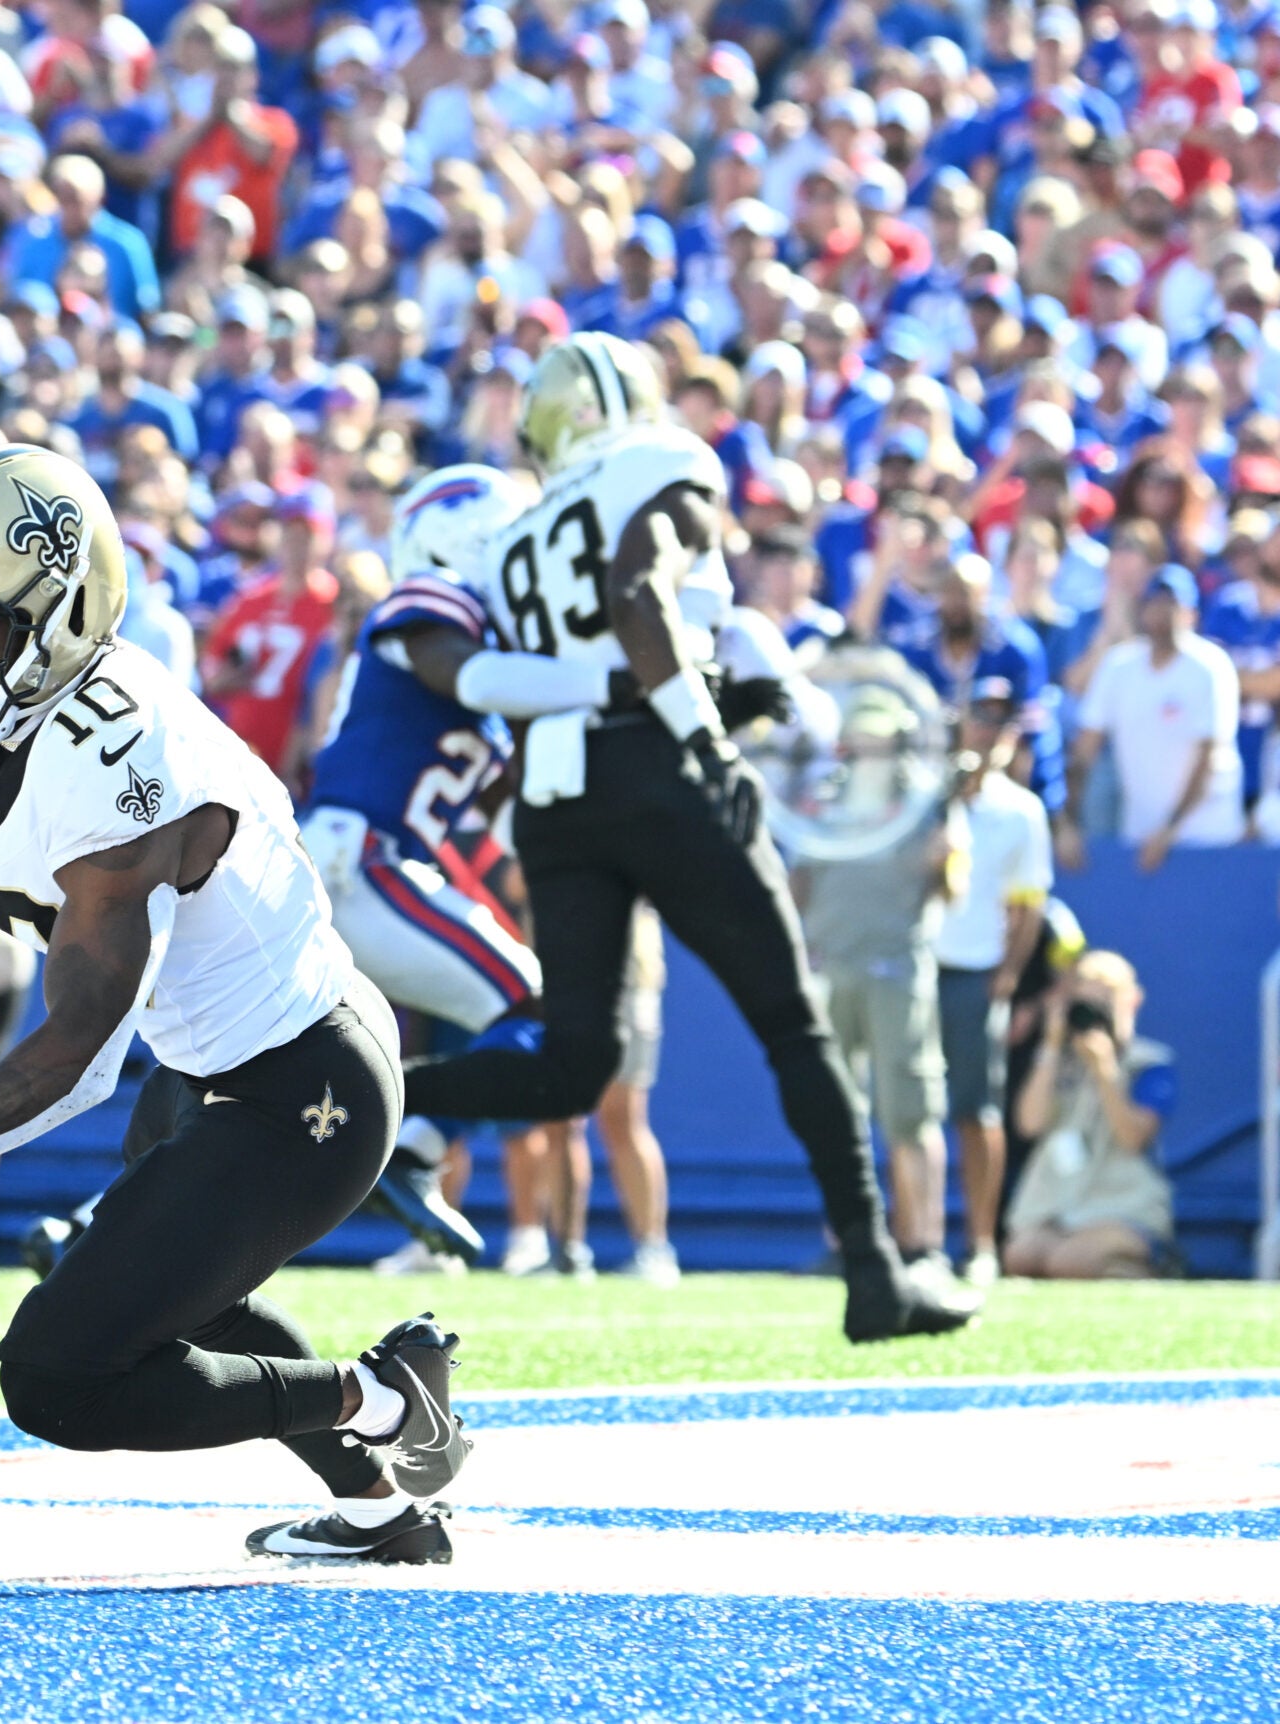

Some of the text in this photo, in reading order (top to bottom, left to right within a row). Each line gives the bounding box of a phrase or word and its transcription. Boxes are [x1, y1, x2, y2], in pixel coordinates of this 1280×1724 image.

[501, 496, 611, 658] 83
[50, 675, 141, 750] 10
[403, 728, 504, 852] 2
